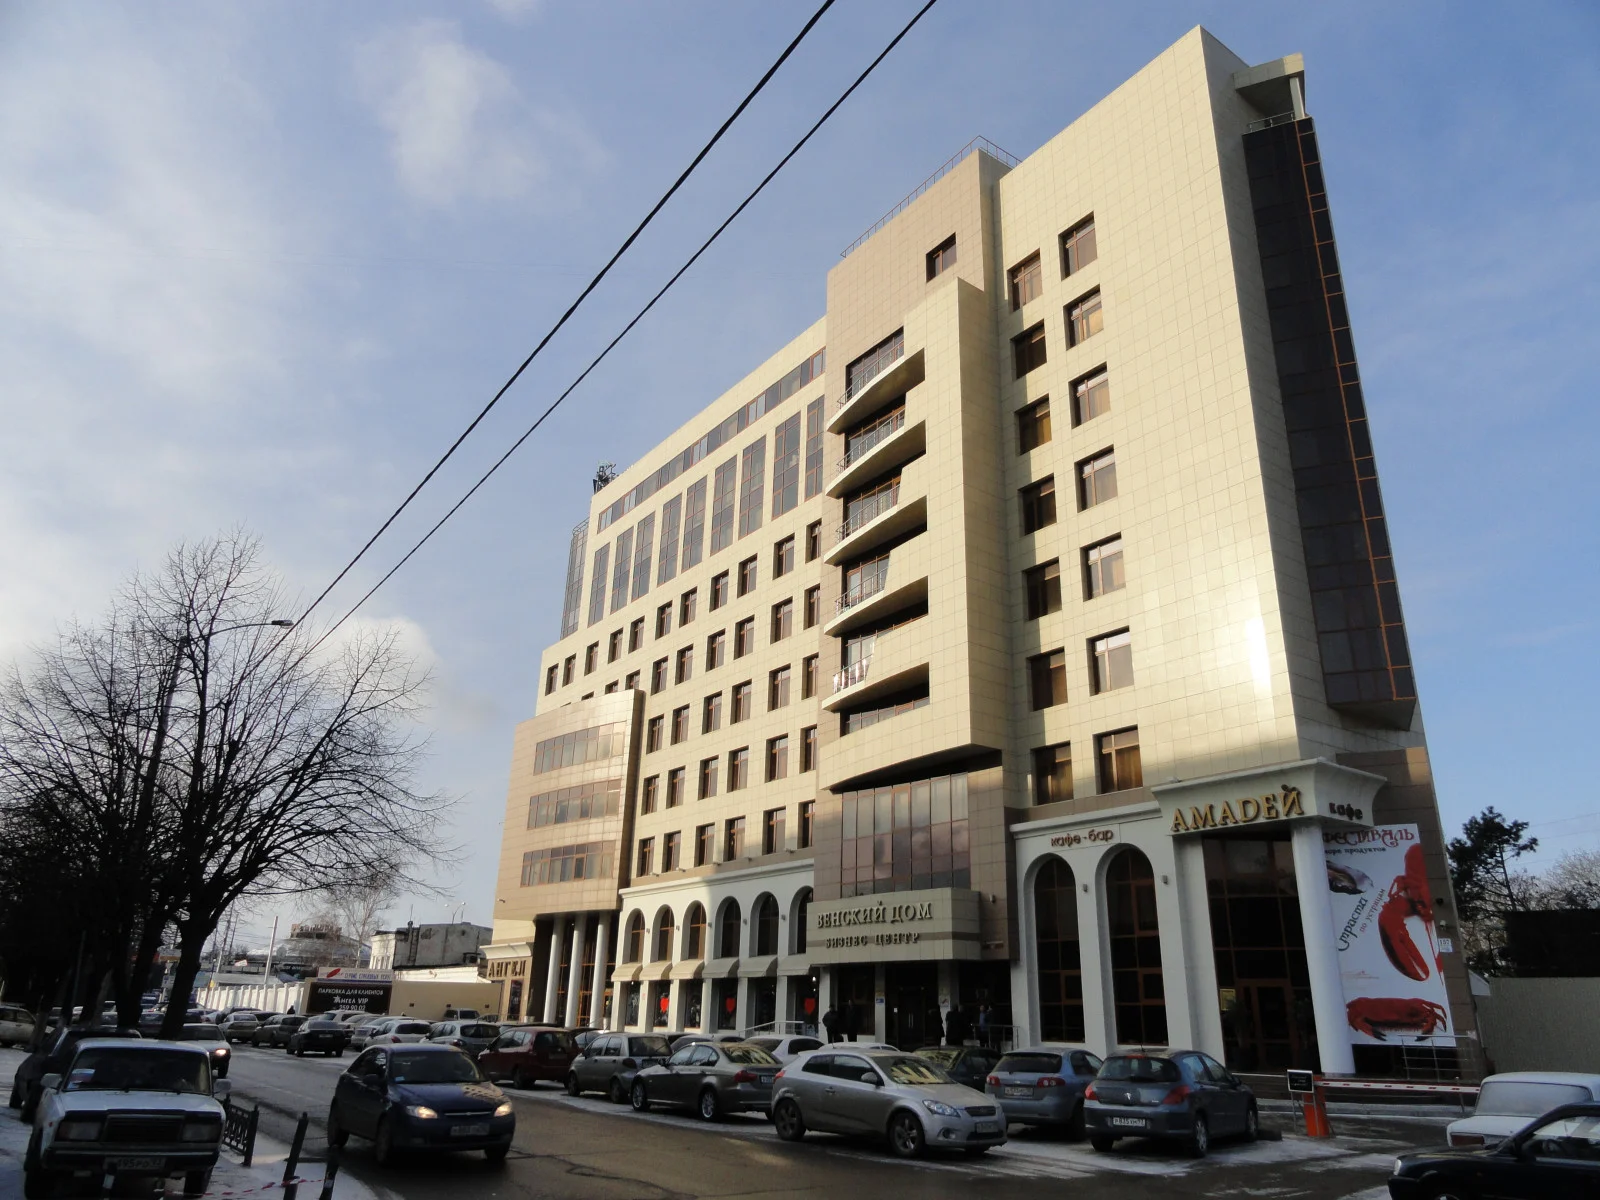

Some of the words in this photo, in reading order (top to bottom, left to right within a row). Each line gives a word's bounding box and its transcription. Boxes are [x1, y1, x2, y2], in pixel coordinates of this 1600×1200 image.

[1328, 802, 1363, 821] кафе
[817, 900, 887, 929] ВЕНСКИЙ
[890, 902, 933, 924] ДОМ
[875, 932, 921, 946] ЦЕНТР
[488, 959, 527, 978] АНГЕЛ
[317, 987, 345, 995] ПАРКОВКА
